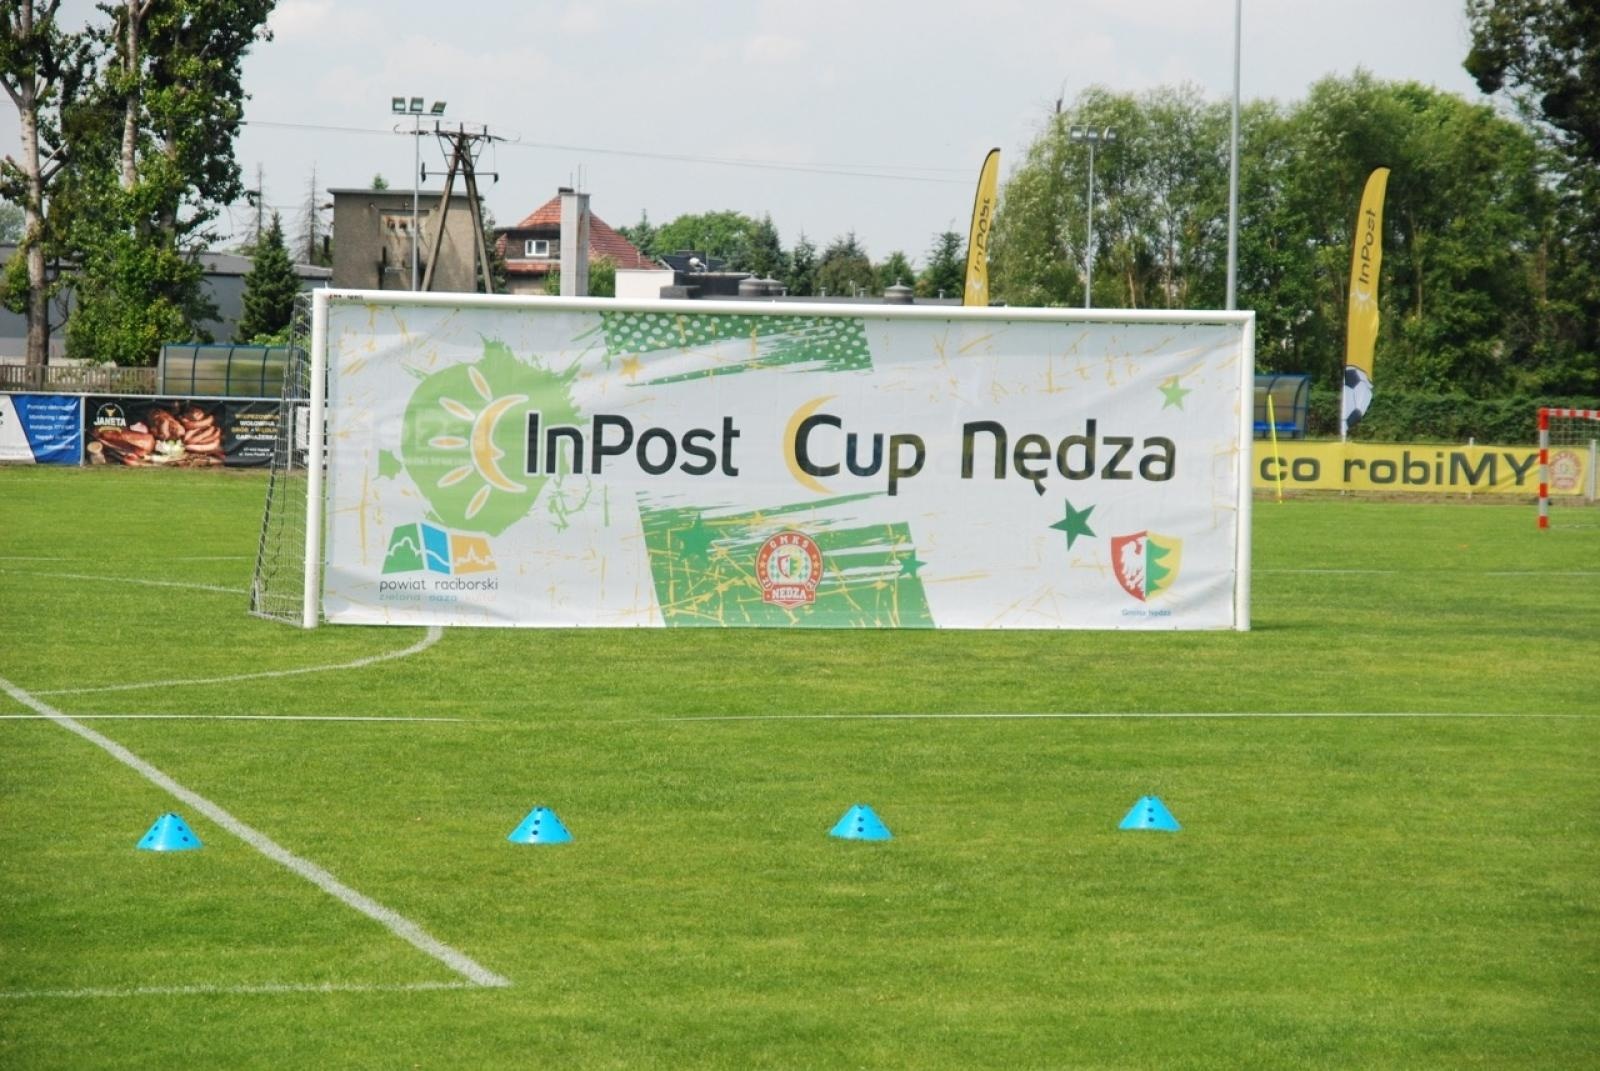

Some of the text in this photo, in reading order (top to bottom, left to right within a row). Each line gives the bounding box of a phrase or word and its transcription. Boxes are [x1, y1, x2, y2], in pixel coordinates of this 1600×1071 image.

[1358, 208, 1376, 284] InPost
[93, 416, 127, 427] JANETA
[526, 412, 741, 477] InPost
[794, 413, 926, 497] Cup
[1259, 450, 1540, 486] co robiMY
[379, 577, 499, 593] powiat raciborski
